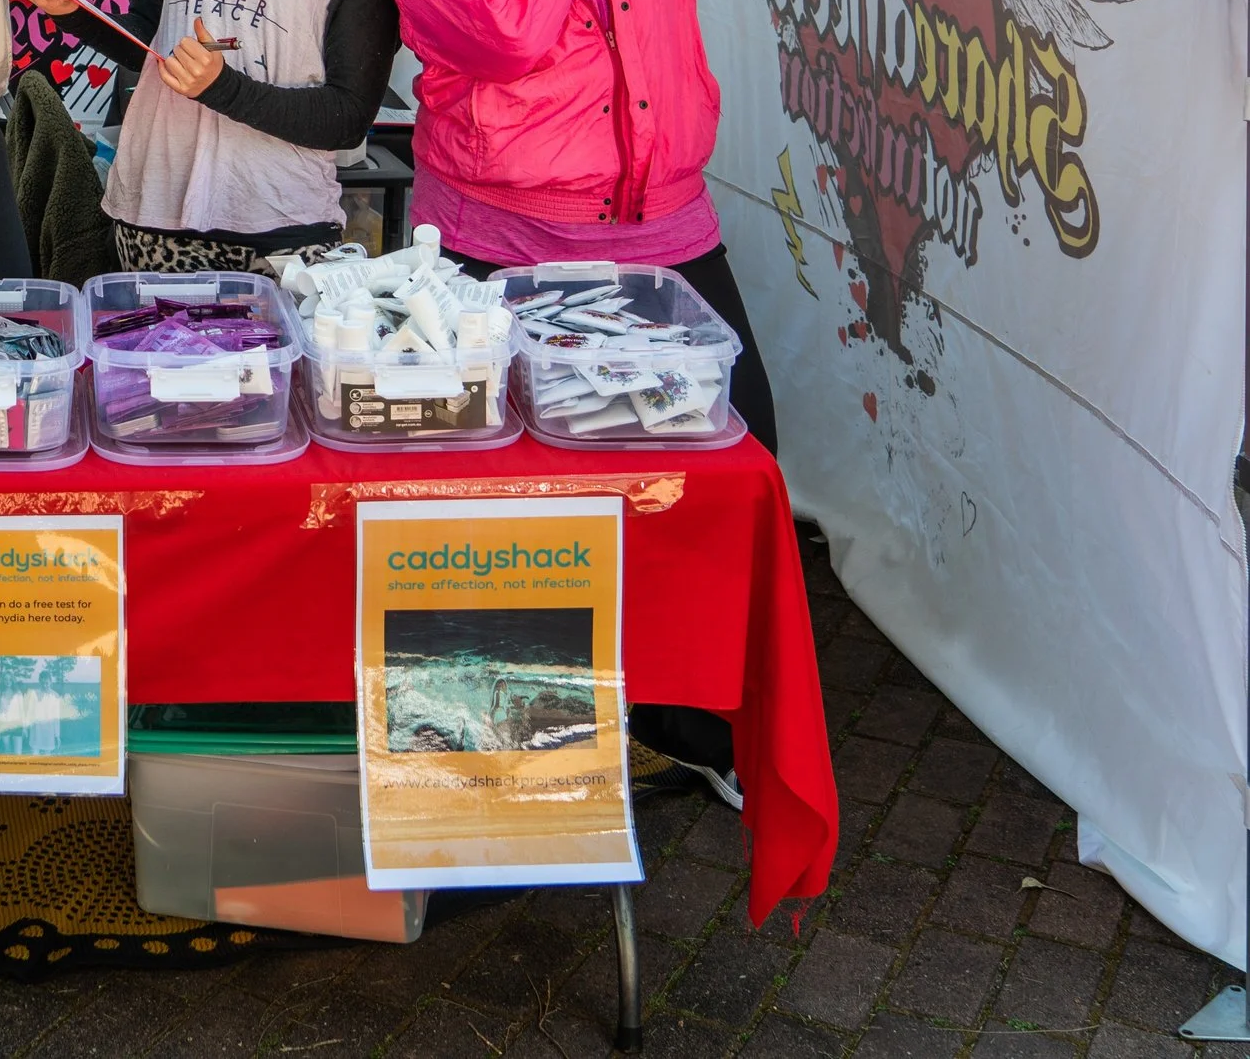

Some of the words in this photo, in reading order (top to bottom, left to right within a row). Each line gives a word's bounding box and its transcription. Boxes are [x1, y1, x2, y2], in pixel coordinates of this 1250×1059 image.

[387, 541, 591, 576] caddyshack
[37, 575, 54, 583] not
[388, 579, 425, 591] share
[431, 578, 498, 591] affection,
[503, 579, 526, 589] not
[532, 577, 591, 589] infection
[9, 600, 22, 609] do
[24, 601, 31, 609] a
[33, 600, 53, 609] free
[55, 600, 75, 609] test
[77, 600, 92, 609] for
[28, 613, 51, 623] here
[54, 614, 85, 624] today.
